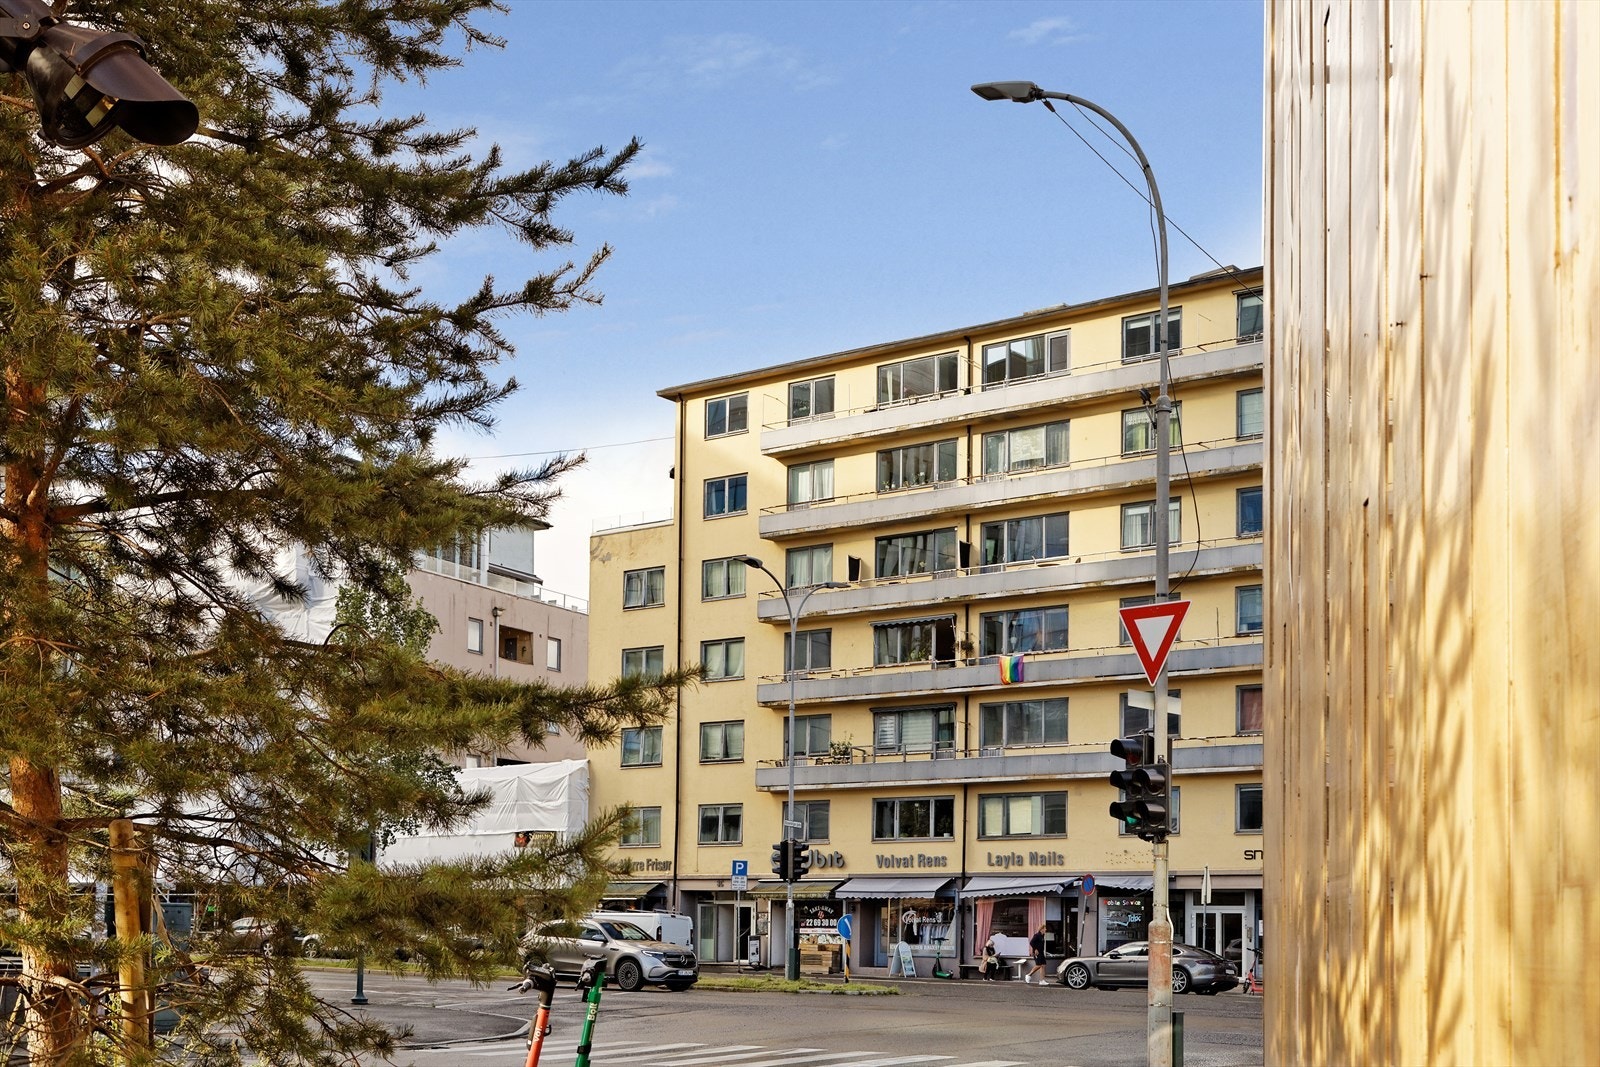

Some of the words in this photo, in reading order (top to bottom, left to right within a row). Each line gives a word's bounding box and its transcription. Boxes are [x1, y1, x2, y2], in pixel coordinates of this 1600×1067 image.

[735, 862, 744, 874] P
[876, 854, 914, 869] Volvat
[917, 853, 948, 868] Rens
[987, 851, 1023, 869] Layla
[1029, 851, 1064, 866] Nails
[806, 918, 813, 927] 22
[587, 1002, 598, 1021] Bolt
